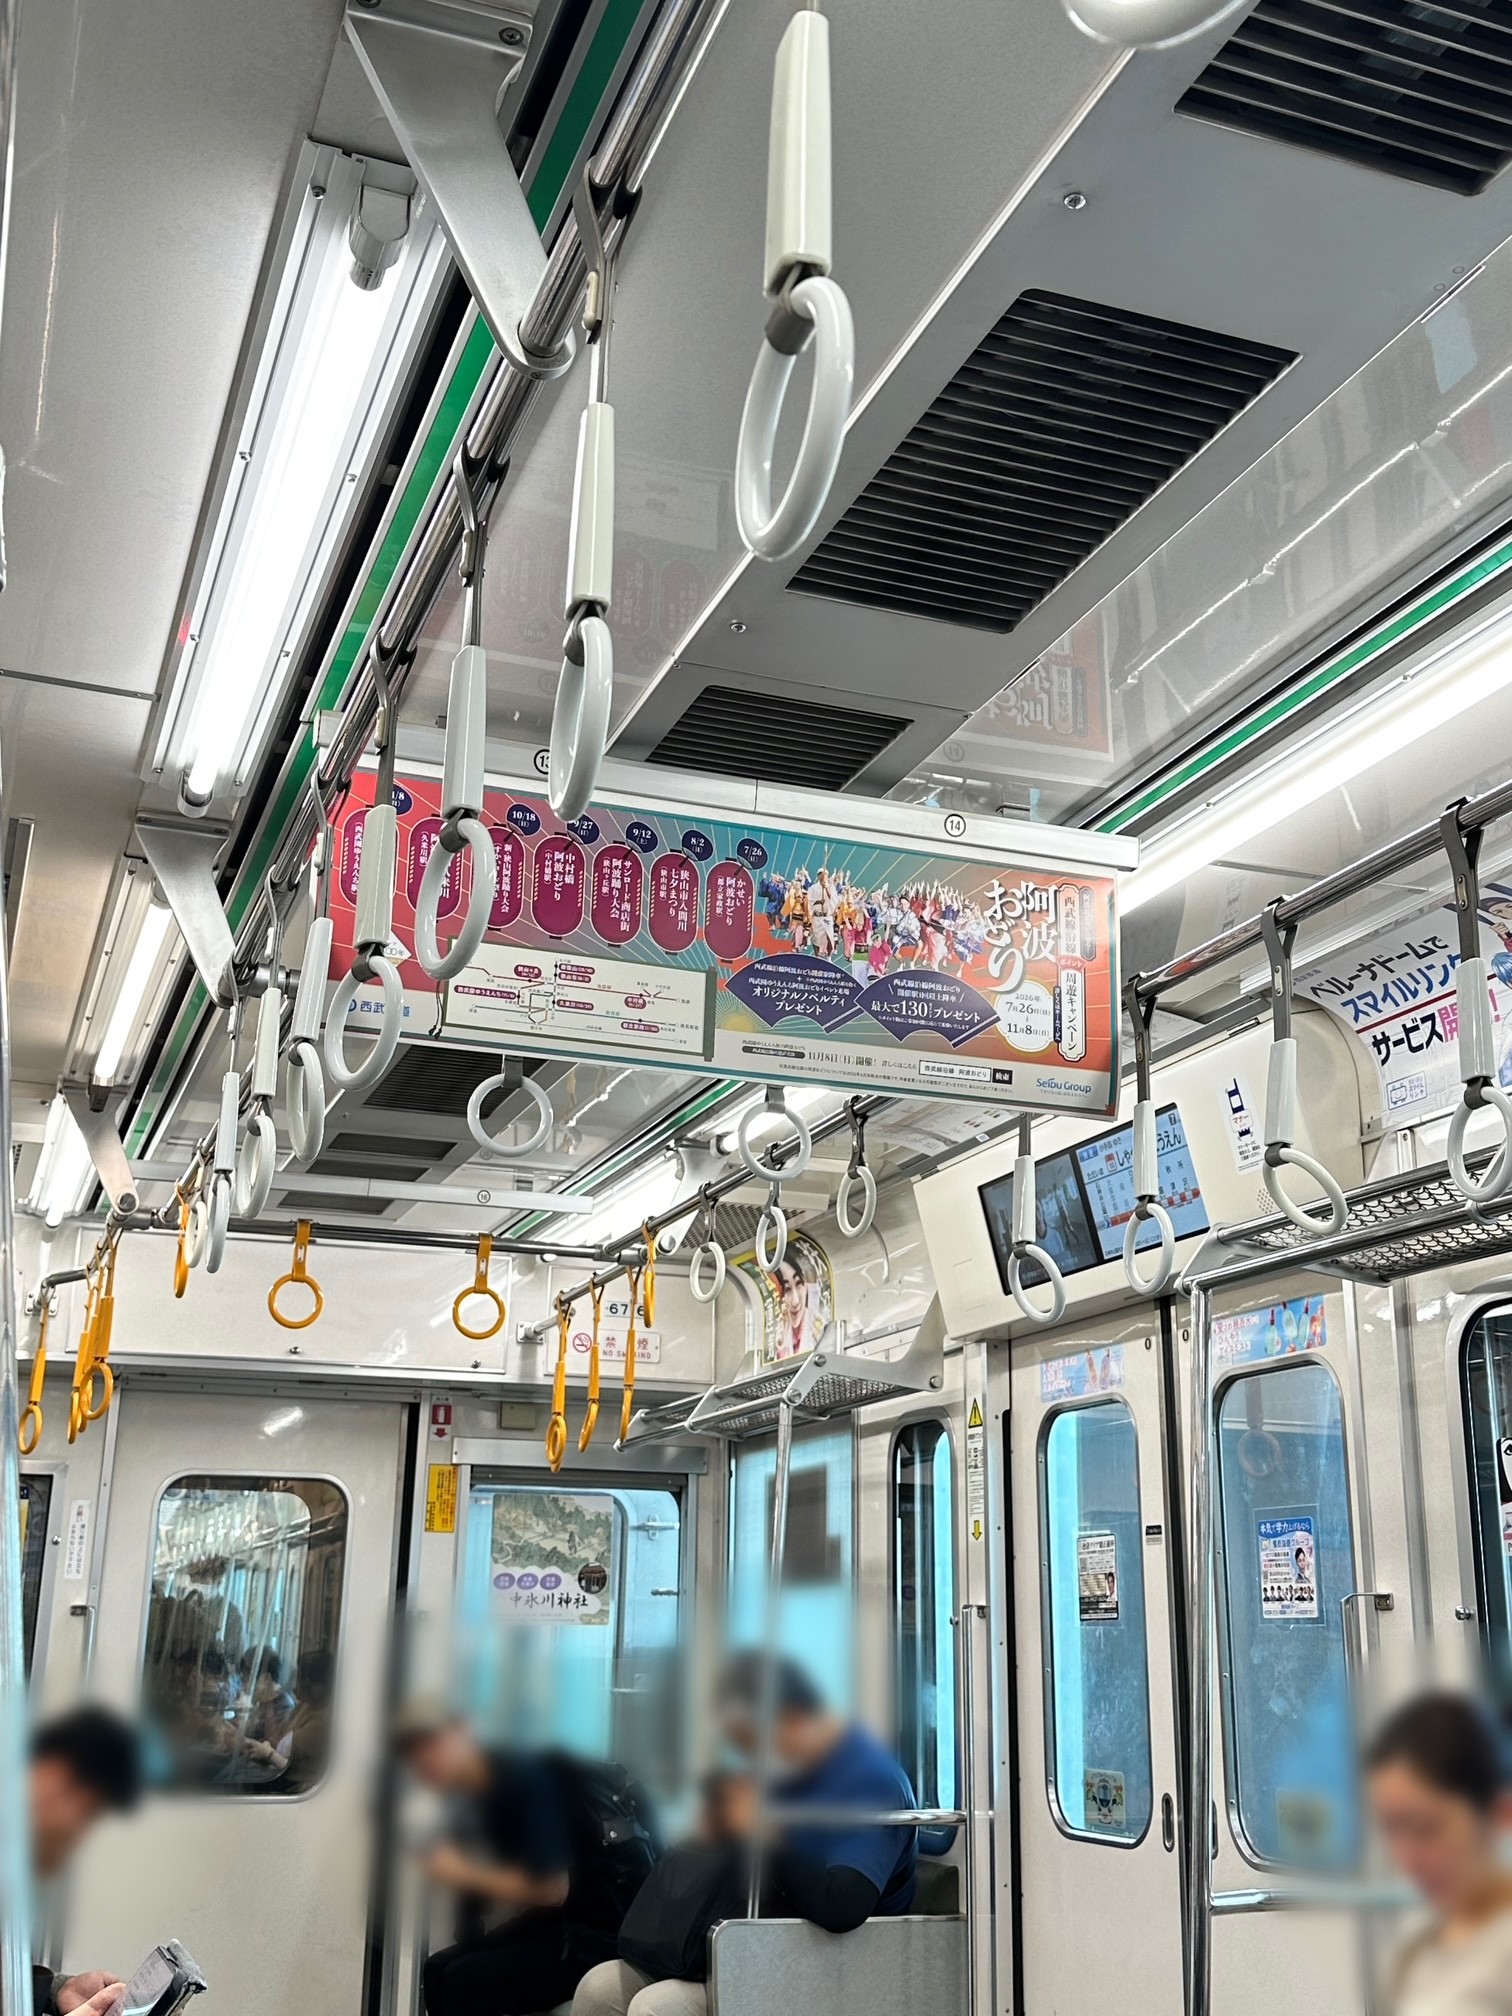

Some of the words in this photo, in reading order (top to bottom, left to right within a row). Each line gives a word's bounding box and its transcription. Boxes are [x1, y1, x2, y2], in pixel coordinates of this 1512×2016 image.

[392, 791, 405, 801] 1/8
[512, 811, 536, 822] 10/18
[573, 820, 594, 829] 9/27
[632, 828, 652, 839] 9/12
[950, 820, 961, 831] 14
[690, 837, 705, 847] 8/2
[744, 846, 763, 856] 7/26
[544, 849, 553, 885] (中村橋駅)
[565, 853, 576, 885] 中村橋
[553, 851, 565, 901] 阿波おどり
[659, 866, 668, 901] (狭山市駅)
[610, 859, 623, 919] 阿波踊り大会
[620, 860, 632, 932] サンロード商店街
[668, 868, 680, 918] 七夕まつり
[736, 878, 746, 907] かせい
[677, 869, 690, 932] 狭山市入間川
[725, 877, 736, 926] 阿波おどり
[1021, 880, 1058, 964] 阿波
[1064, 896, 1078, 955] 西武線沿線
[983, 879, 1024, 992] おどり
[1310, 935, 1449, 999] ベルーナドームで
[752, 986, 845, 1007] オリジナルノベルティ
[1015, 993, 1041, 1003] 2026年
[360, 1000, 411, 1018] 西武道
[775, 1000, 823, 1016] プレゼント
[1066, 972, 1078, 1051] 周遊キャンペーン
[1372, 988, 1500, 1067] サービス開!
[882, 1060, 917, 1070] 詳しくはこちら
[924, 1065, 955, 1074] 西武線沿線
[958, 1069, 987, 1079] 阿波おどり
[1036, 1078, 1063, 1090] Seibu
[1064, 1081, 1092, 1093] Group
[1408, 1090, 1425, 1100] リンク
[1169, 1114, 1177, 1125] 7
[1232, 1114, 1249, 1124] マナー
[609, 1303, 644, 1316] 676
[606, 1336, 648, 1350] 禁煙
[617, 1350, 651, 1359] SMING
[1260, 1521, 1310, 1534] 本気で学力上げるなら
[510, 1591, 588, 1609] 中氷川神社
